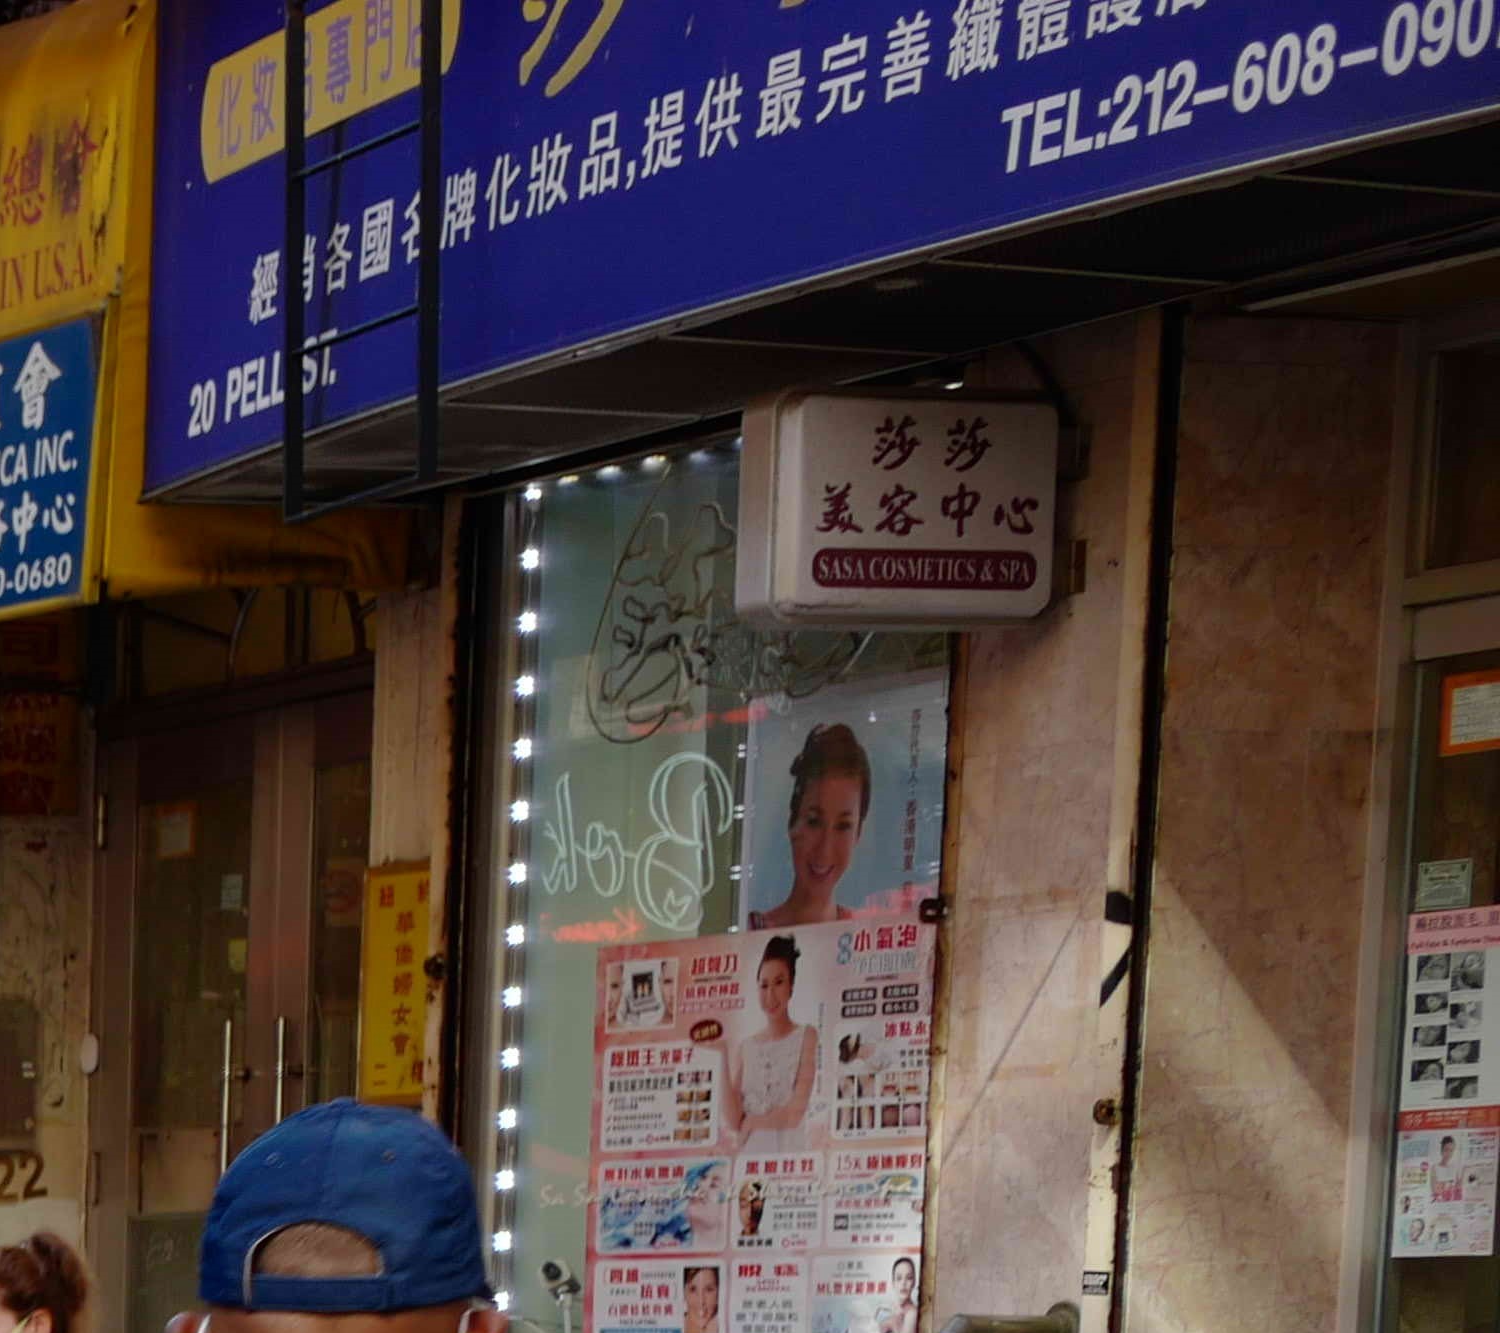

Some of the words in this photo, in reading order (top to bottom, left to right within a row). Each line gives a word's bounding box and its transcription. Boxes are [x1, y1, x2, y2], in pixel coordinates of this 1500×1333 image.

[1001, 0, 1500, 174] TEL:212-608-090
[0, 254, 28, 311] IN
[187, 380, 218, 439] 20
[224, 348, 285, 425] PELL
[34, 430, 78, 479] INC.
[871, 416, 993, 473] 莎莎
[815, 481, 1040, 539] 美容中心
[818, 554, 866, 581] SASA
[868, 556, 978, 584] COSMETICS
[980, 559, 995, 583] &
[999, 558, 1031, 586] SPA
